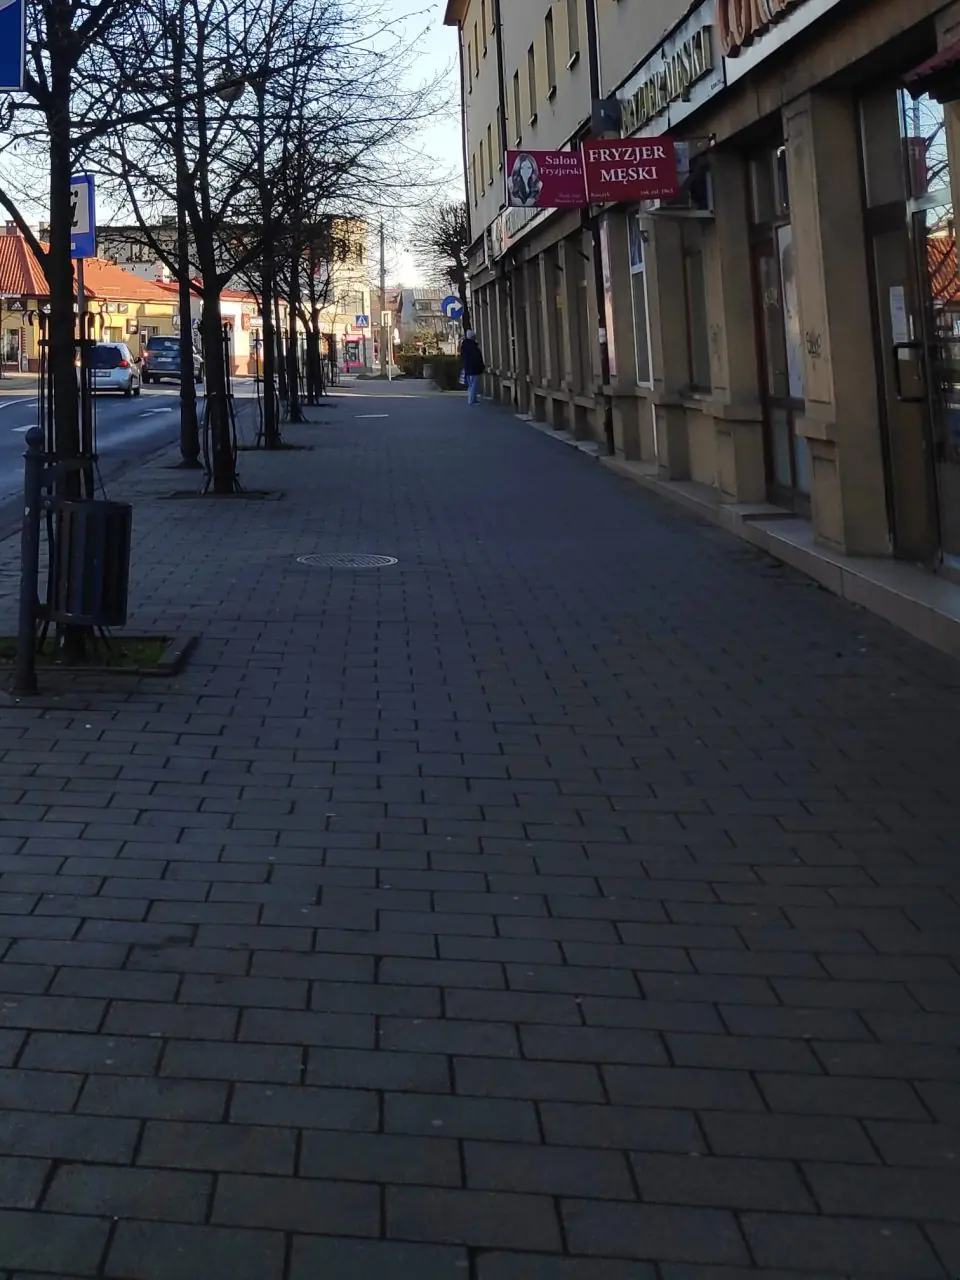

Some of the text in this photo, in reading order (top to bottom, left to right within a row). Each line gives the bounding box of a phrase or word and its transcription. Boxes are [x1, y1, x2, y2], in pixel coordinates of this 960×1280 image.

[545, 155, 577, 165] Salon
[589, 145, 666, 164] FRYZJER
[600, 167, 658, 184] MĘSKI
